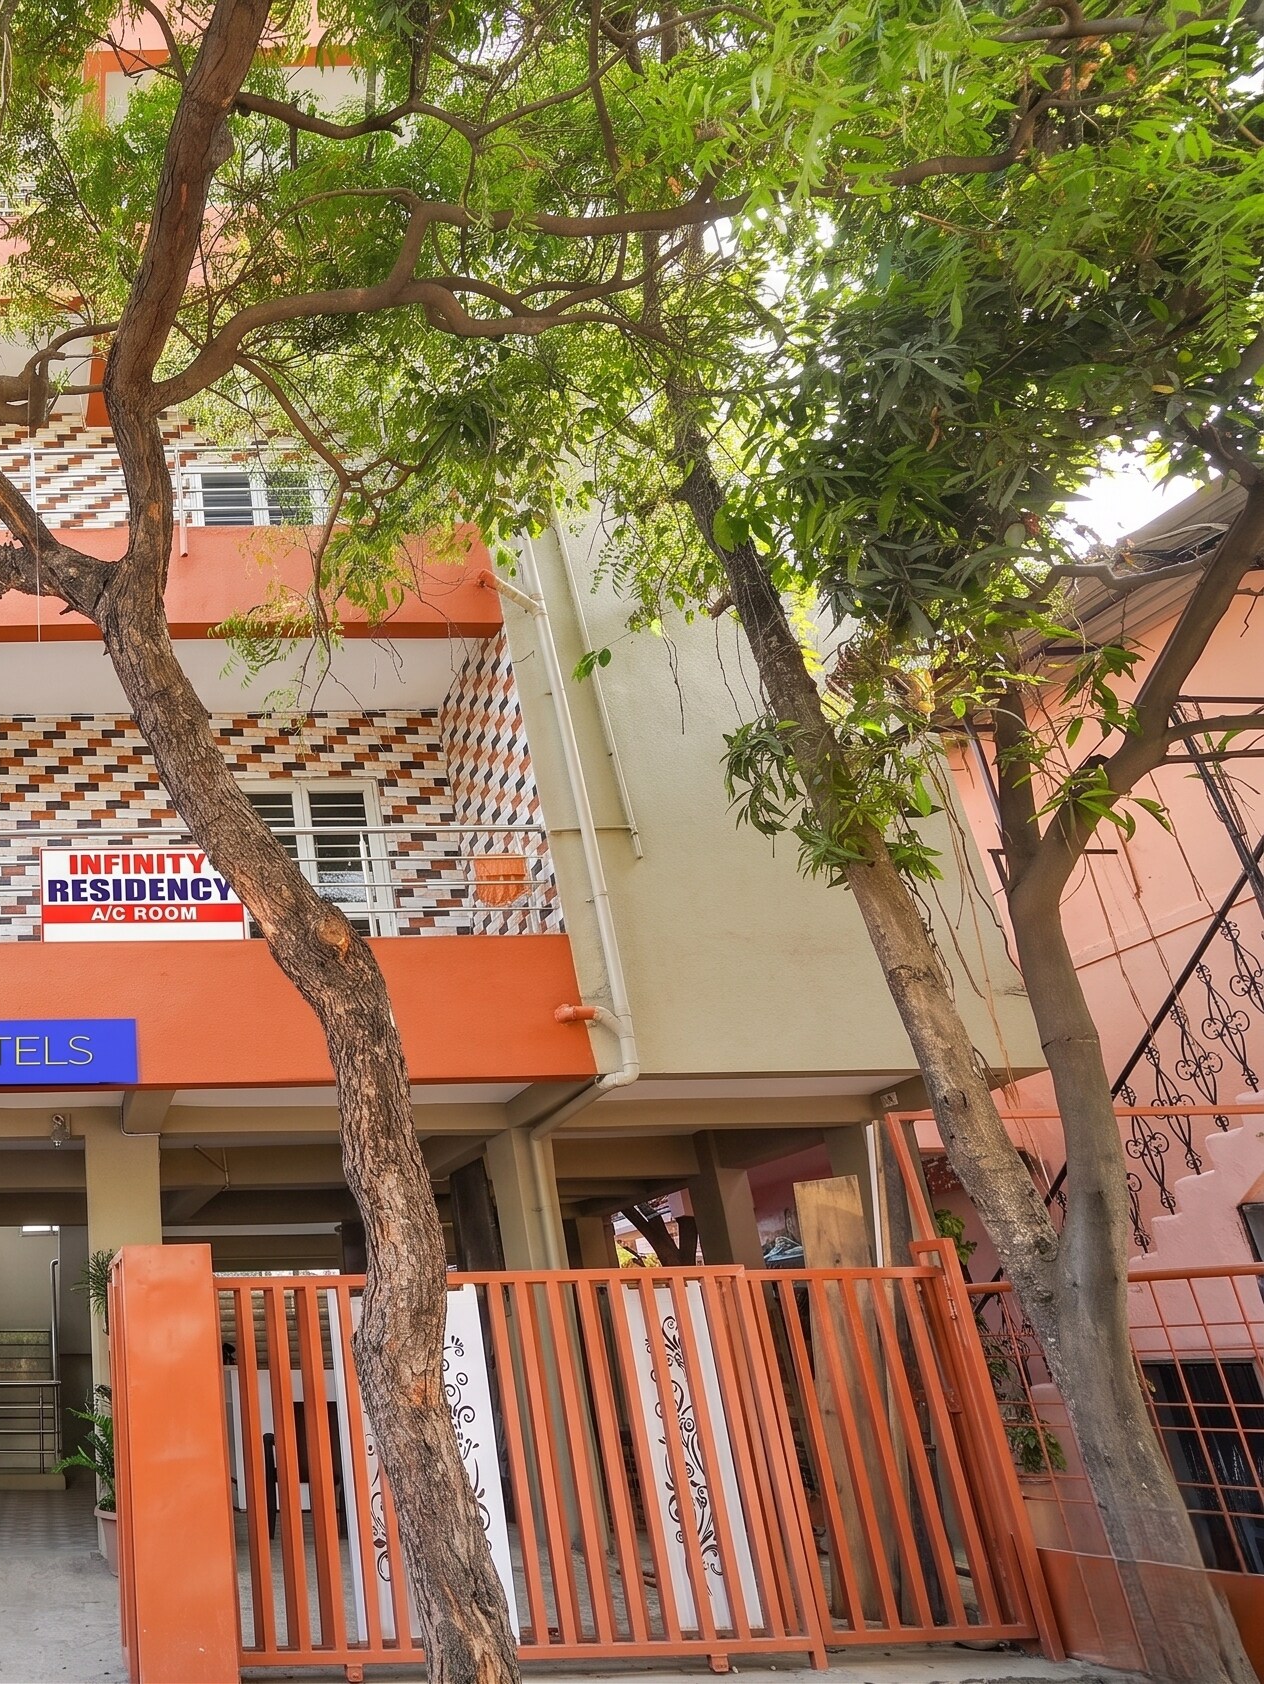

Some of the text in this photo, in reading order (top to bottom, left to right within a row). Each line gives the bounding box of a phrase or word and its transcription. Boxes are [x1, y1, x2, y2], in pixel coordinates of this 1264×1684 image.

[69, 853, 206, 875] INFINITY
[48, 878, 232, 902] RESIDENCY
[91, 905, 197, 921] A/C ROOM
